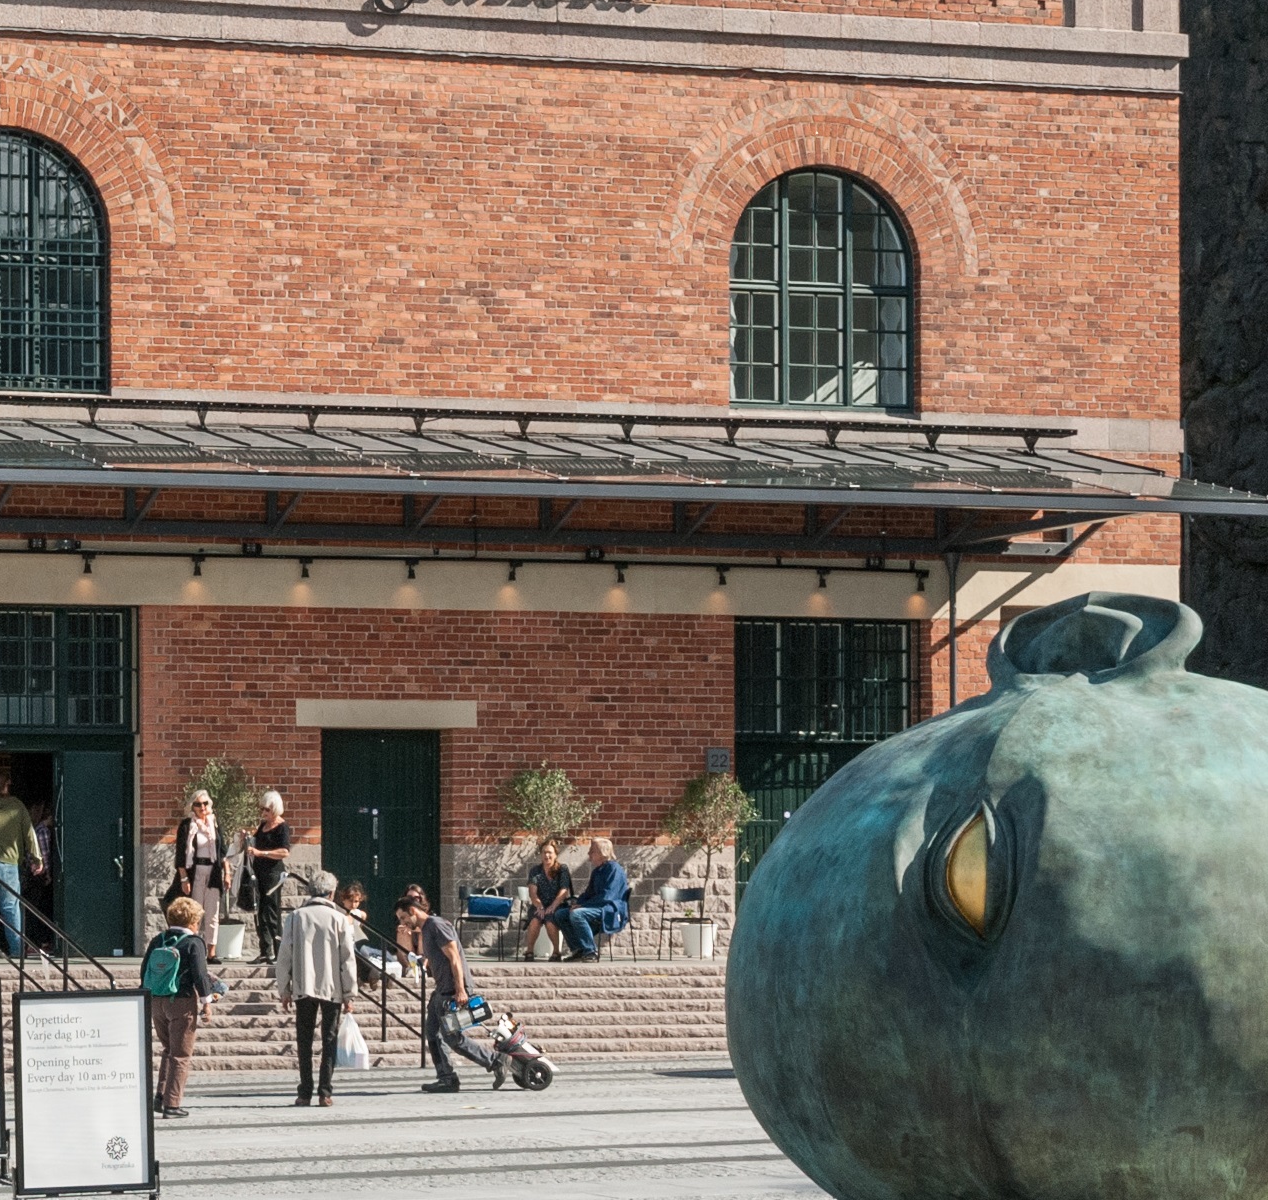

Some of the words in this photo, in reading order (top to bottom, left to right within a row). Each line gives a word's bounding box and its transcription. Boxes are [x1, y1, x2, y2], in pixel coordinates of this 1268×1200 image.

[711, 754, 728, 767] 22
[26, 1013, 82, 1027] Öppettider:
[26, 1030, 52, 1043] Varje
[54, 1029, 72, 1042] dag
[75, 1028, 101, 1039] 10-21
[26, 1057, 70, 1070] Opening
[72, 1056, 103, 1066] hours:
[27, 1073, 55, 1085] Every
[57, 1072, 74, 1084] day
[78, 1071, 89, 1081] 10
[119, 1072, 135, 1082] pm
